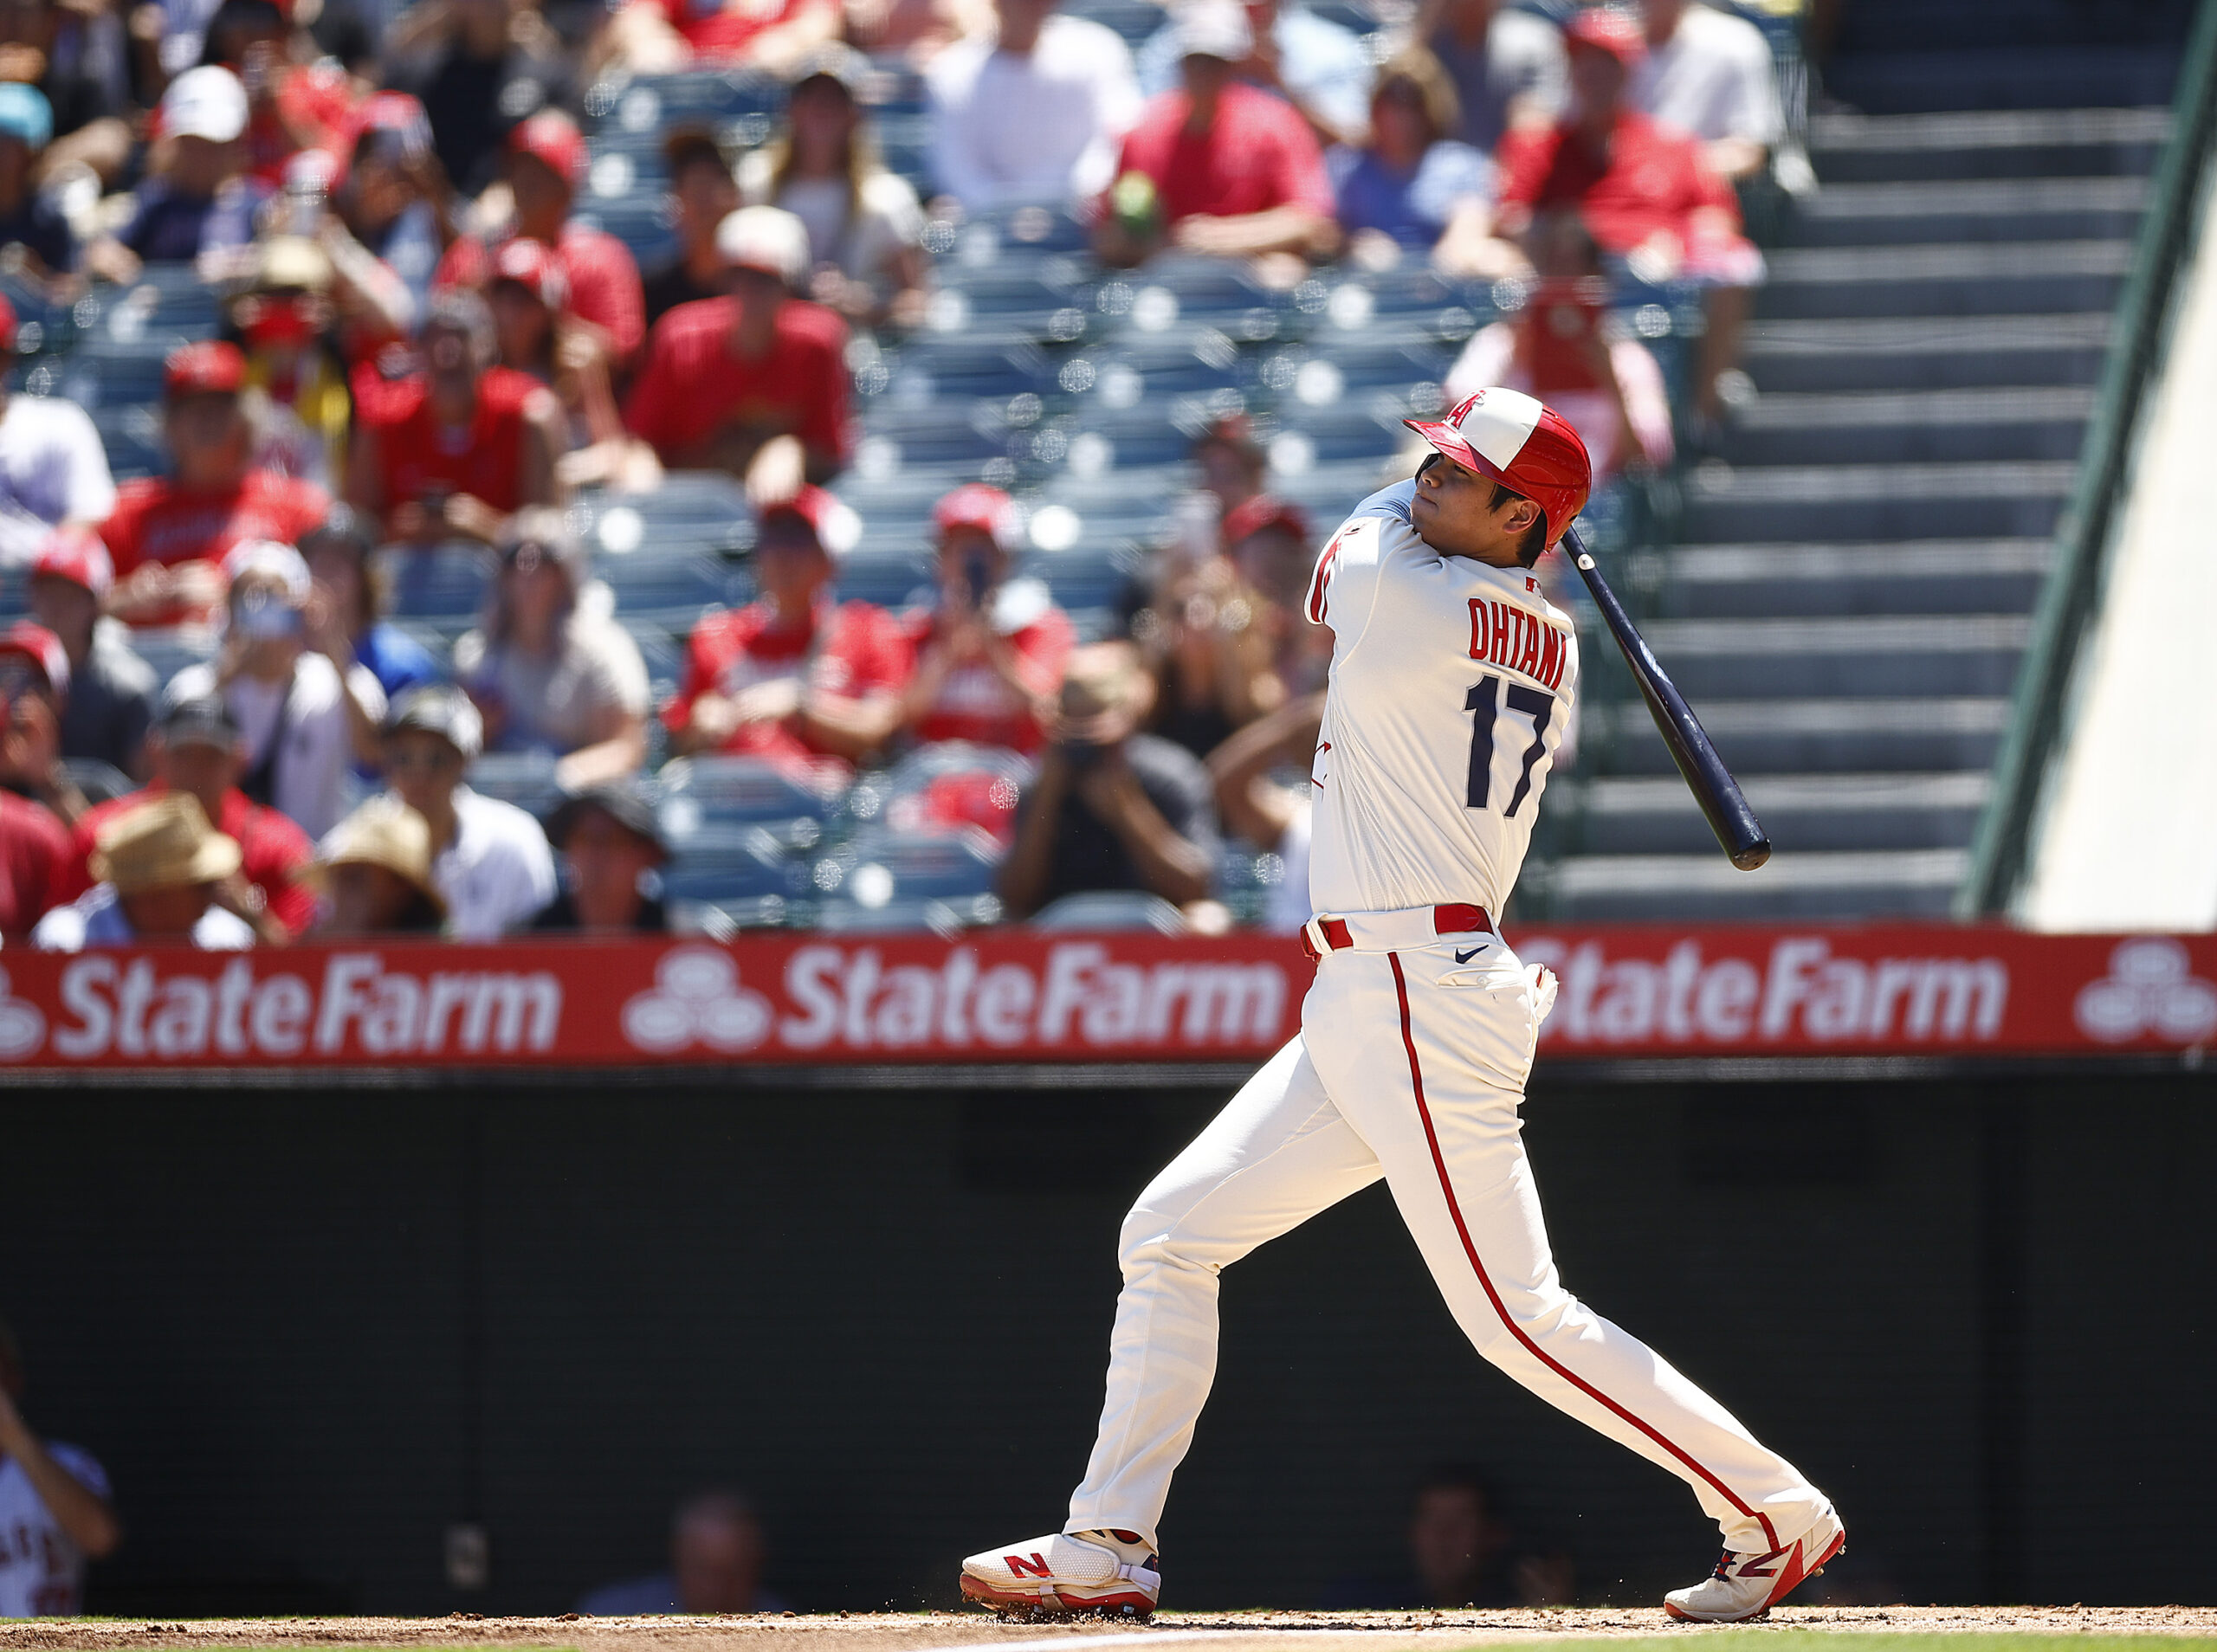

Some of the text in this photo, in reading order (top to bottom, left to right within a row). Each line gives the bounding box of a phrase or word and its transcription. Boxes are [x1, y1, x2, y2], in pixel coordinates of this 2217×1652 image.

[1467, 597, 1567, 692] OHTANI
[1462, 672, 1558, 819] 17
[1004, 1552, 1054, 1578] N
